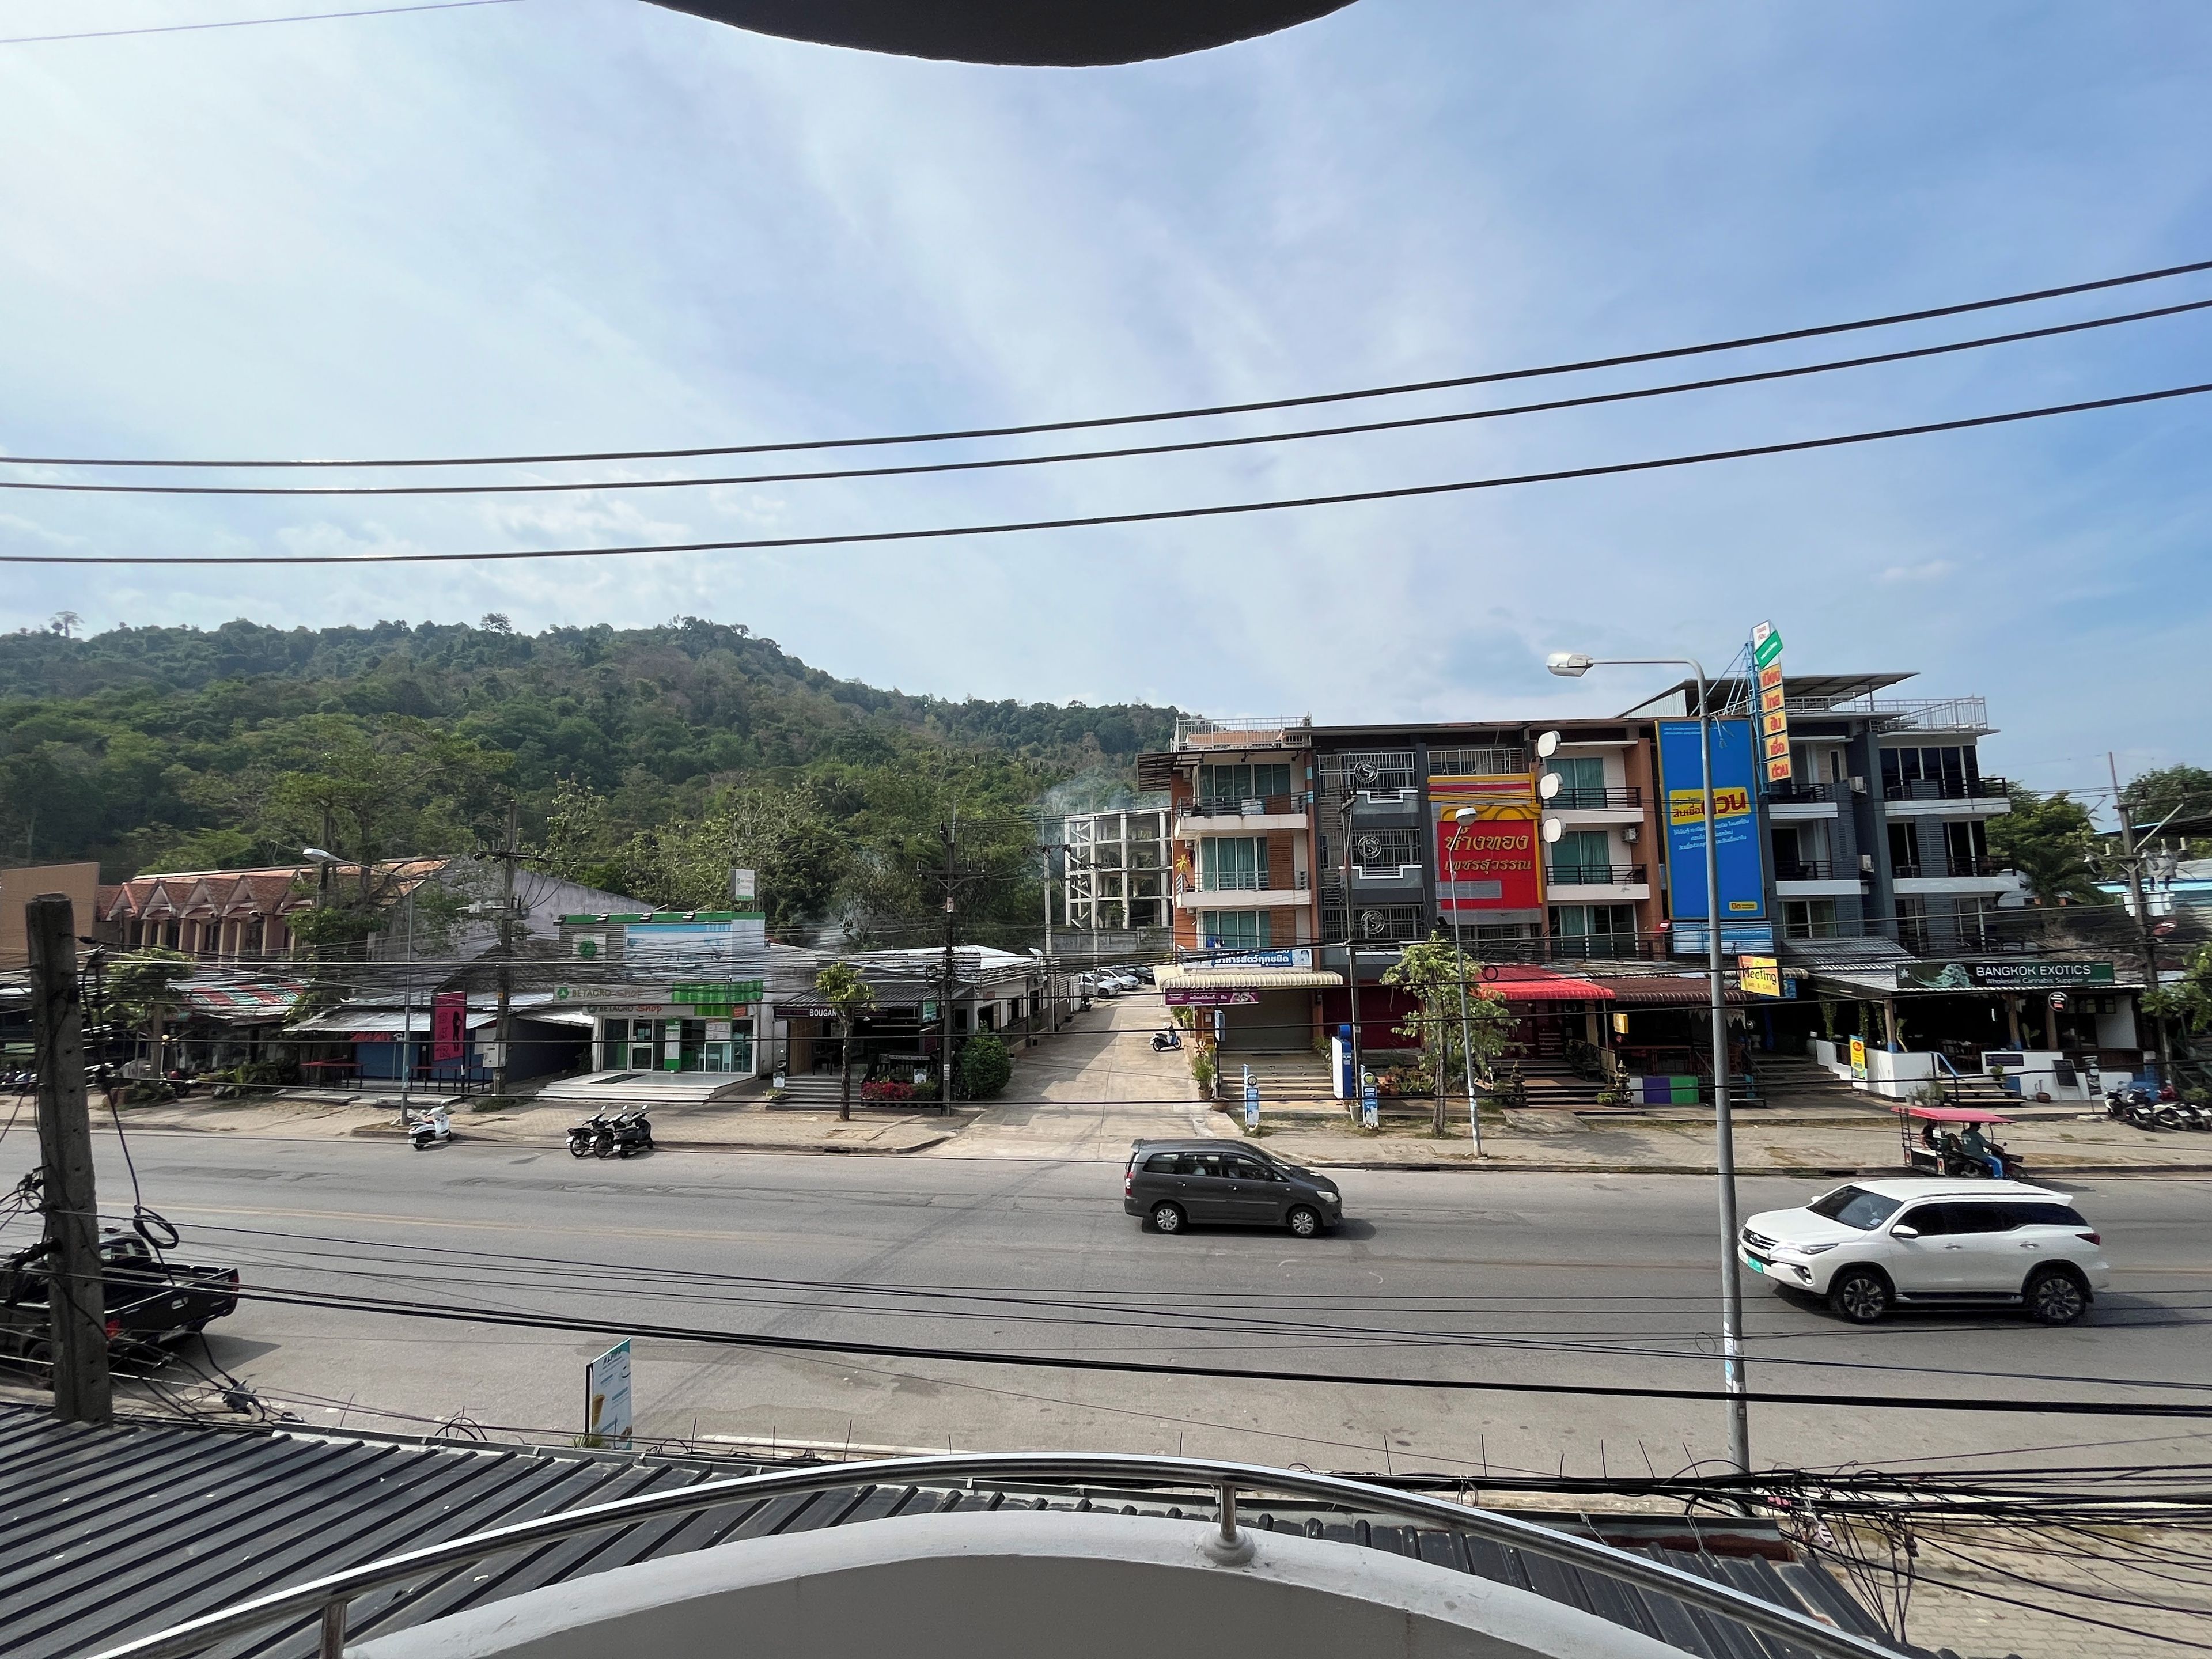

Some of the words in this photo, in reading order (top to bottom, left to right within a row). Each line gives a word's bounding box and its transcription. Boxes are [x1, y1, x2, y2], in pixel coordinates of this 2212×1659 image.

[1673, 803, 1700, 818] สินเชื่อ
[1700, 791, 1747, 816] วน
[1742, 965, 1777, 985] Meeting
[1976, 965, 2036, 976] BANGKOK
[2040, 965, 2091, 975] EXOTICS
[572, 988, 611, 997] BETAGRO
[809, 1009, 846, 1017] BOUGANL
